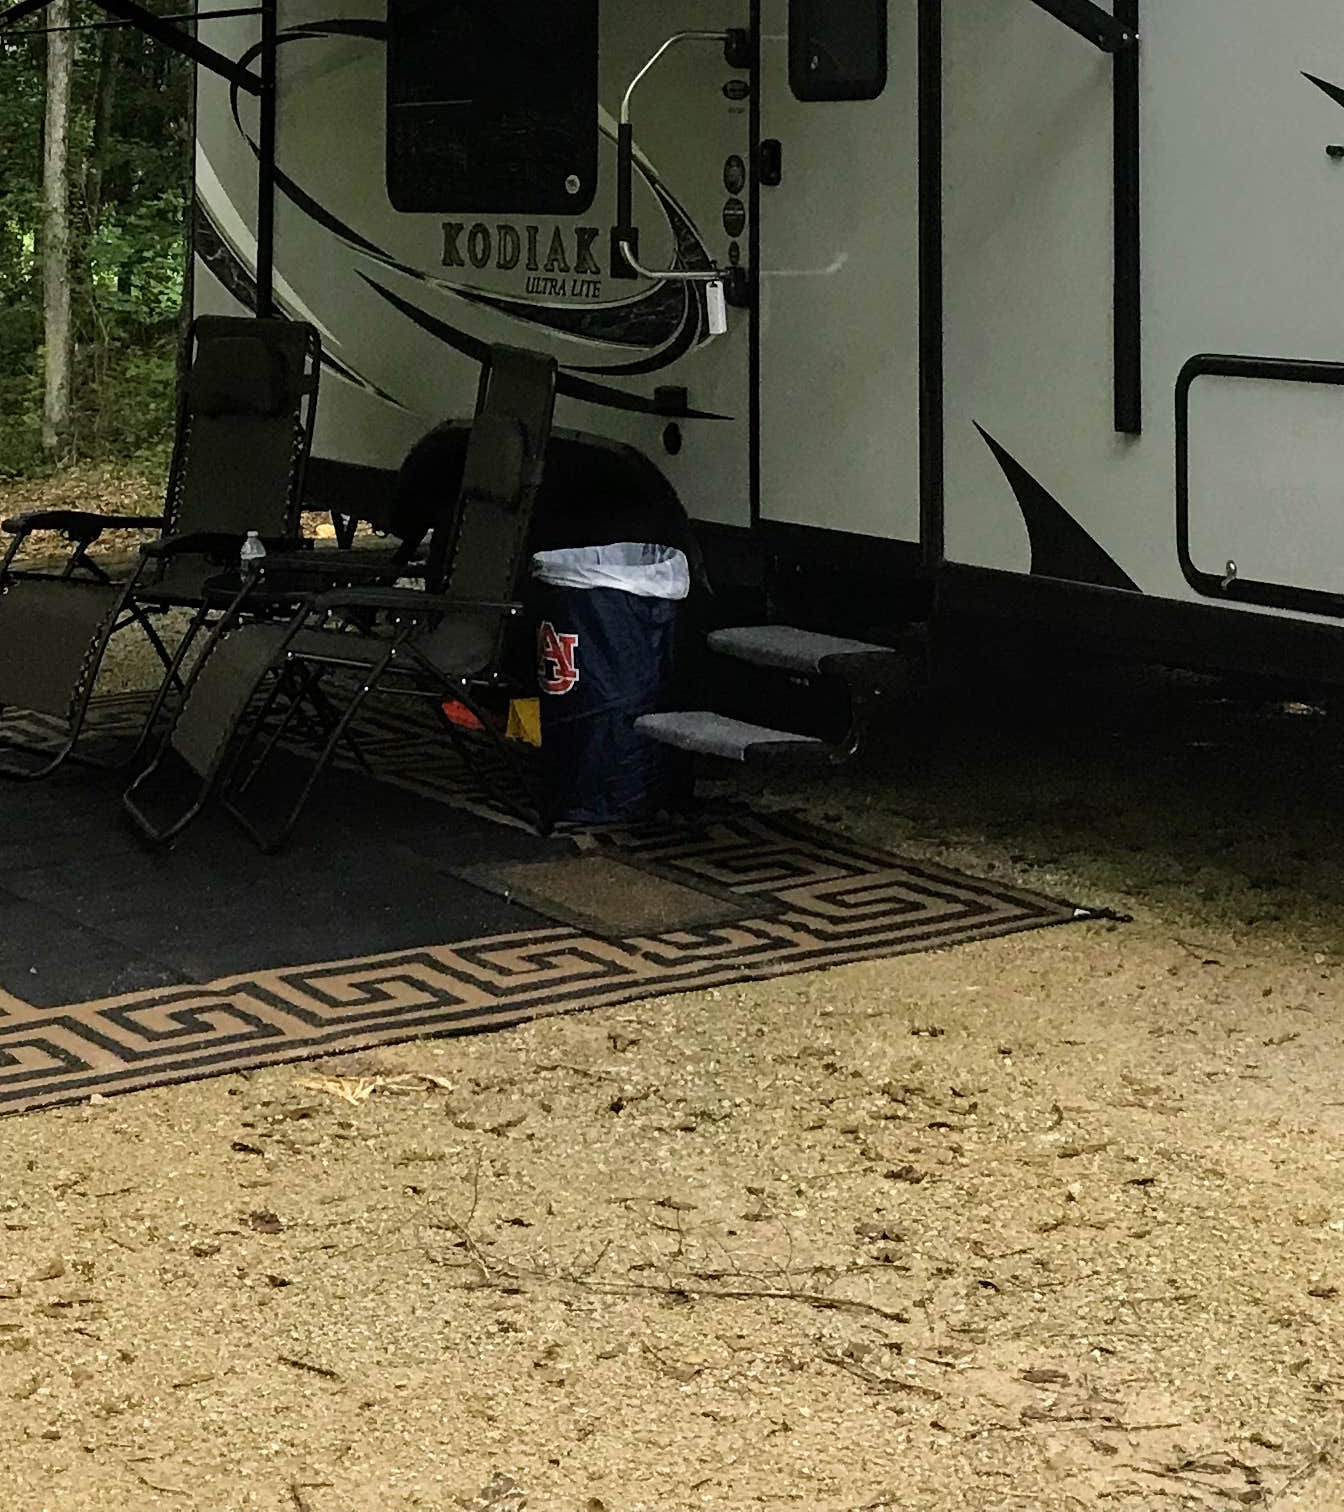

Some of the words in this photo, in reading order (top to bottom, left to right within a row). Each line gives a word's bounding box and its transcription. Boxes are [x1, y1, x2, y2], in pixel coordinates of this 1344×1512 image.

[441, 222, 601, 275] KODIAK
[525, 276, 566, 296] ULTRA
[571, 279, 601, 298] LITE
